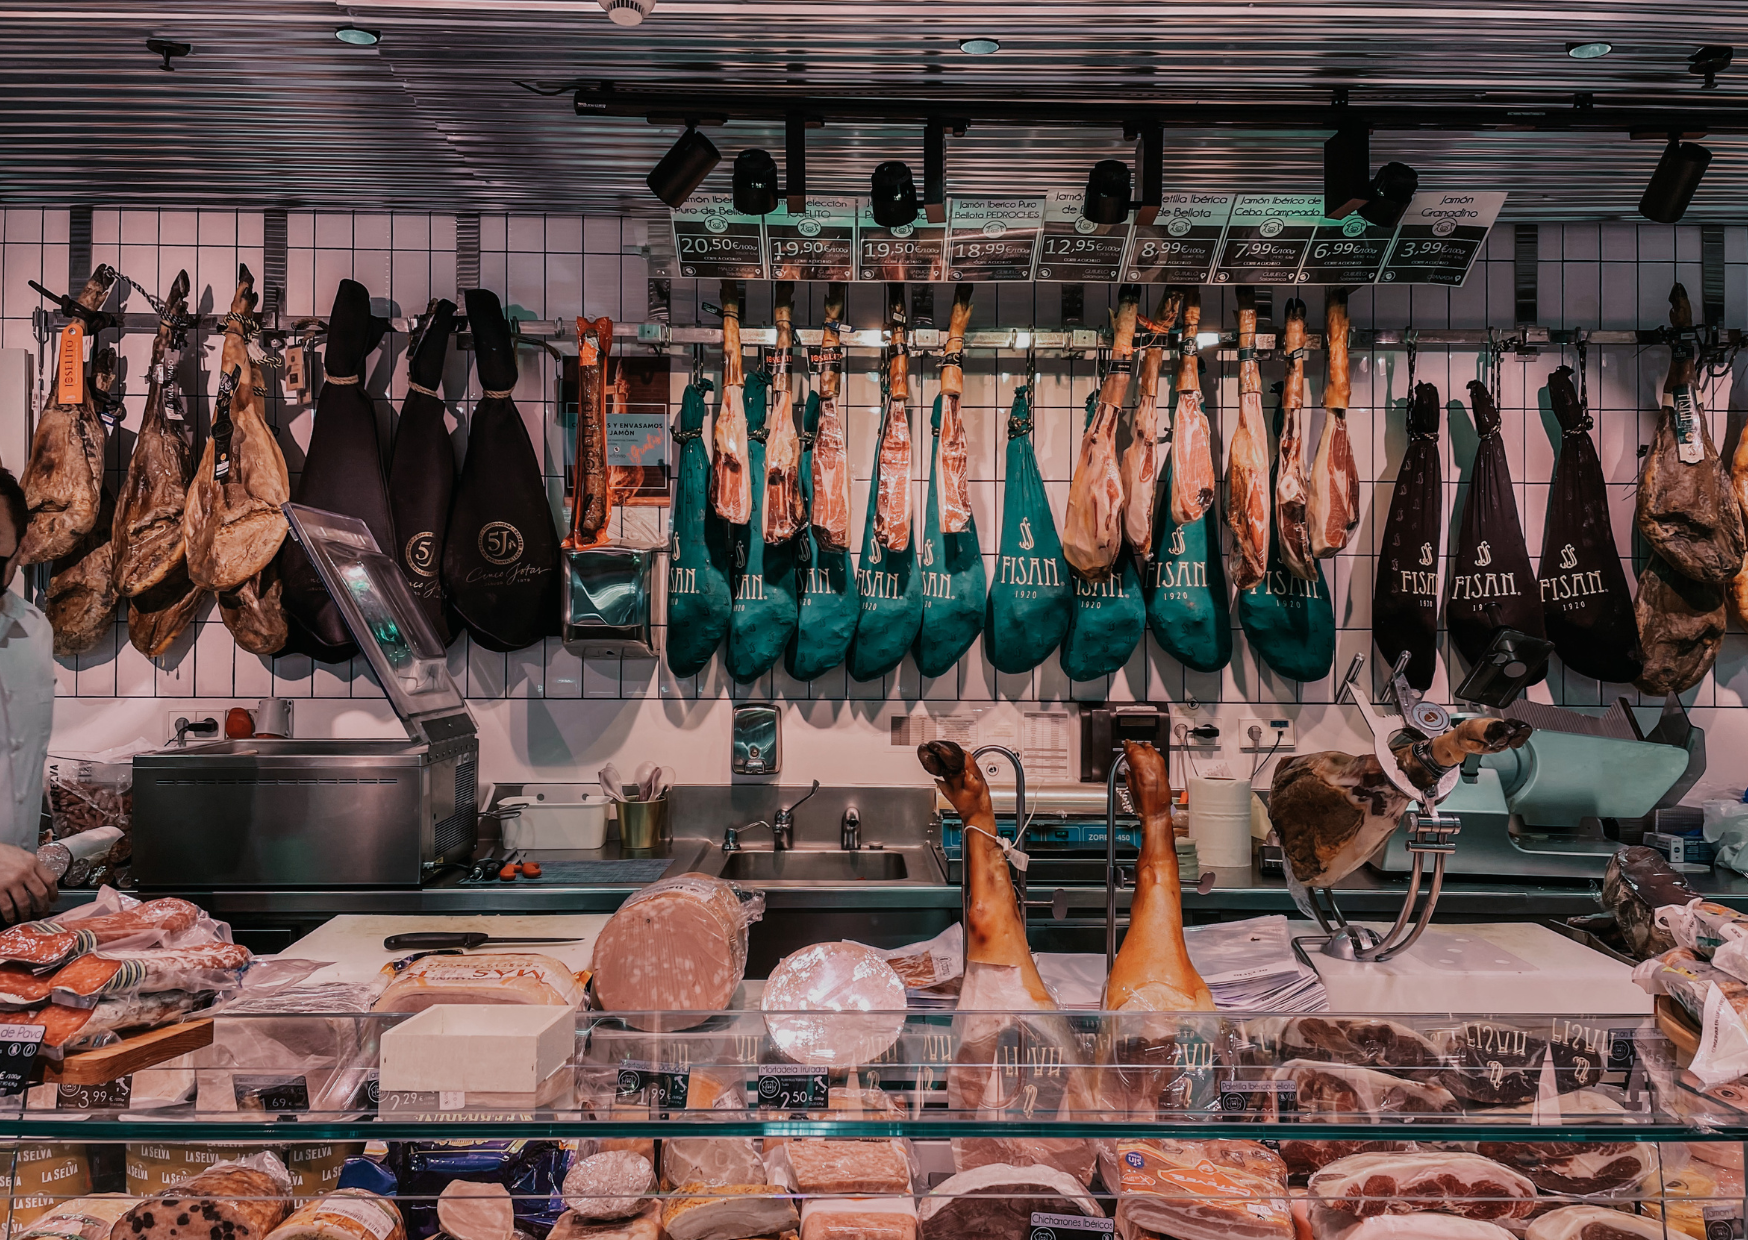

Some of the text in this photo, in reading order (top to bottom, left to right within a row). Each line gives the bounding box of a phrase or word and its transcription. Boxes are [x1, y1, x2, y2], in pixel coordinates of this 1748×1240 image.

[806, 199, 847, 208] elección
[959, 200, 1037, 209] Jamón Puro
[1161, 194, 1228, 204] etilla Ibérica
[1240, 197, 1322, 205] Jamón Ibérico de
[1439, 195, 1475, 206] Jamón
[674, 207, 698, 215] Puro
[700, 206, 716, 215] de
[954, 211, 1040, 219] Bellota PEDROCHES
[1061, 205, 1077, 215] de
[1157, 208, 1212, 218] de Bellota
[1234, 208, 1321, 218] Cebo Campeado
[1421, 208, 1479, 219] Granadino
[65, 340, 74, 387] JOSELITO
[1001, 556, 1060, 586] FISAN
[1452, 573, 1517, 600] FISAN
[1540, 571, 1606, 602] FISAN
[1015, 591, 1037, 599] 1920
[1164, 591, 1188, 601] 1920
[1081, 601, 1101, 609] 1920
[1276, 600, 1301, 609] 1920
[1563, 601, 1586, 611] 1920
[0, 1027, 43, 1039] de Pavo
[760, 1065, 798, 1074] Mortadela
[23, 1148, 53, 1162] SELVA
[141, 1145, 171, 1160] LA SELVA
[185, 1151, 220, 1163] LA SELVA
[294, 1146, 332, 1162] LA SELVA
[41, 1164, 79, 1183] LA SELVA
[131, 1165, 149, 1180] SELVA
[162, 1172, 170, 1184] LA
[322, 1170, 332, 1181] LA
[13, 1197, 54, 1210] LA SELVA
[1032, 1213, 1112, 1230] Chicharrones Ibéricos
